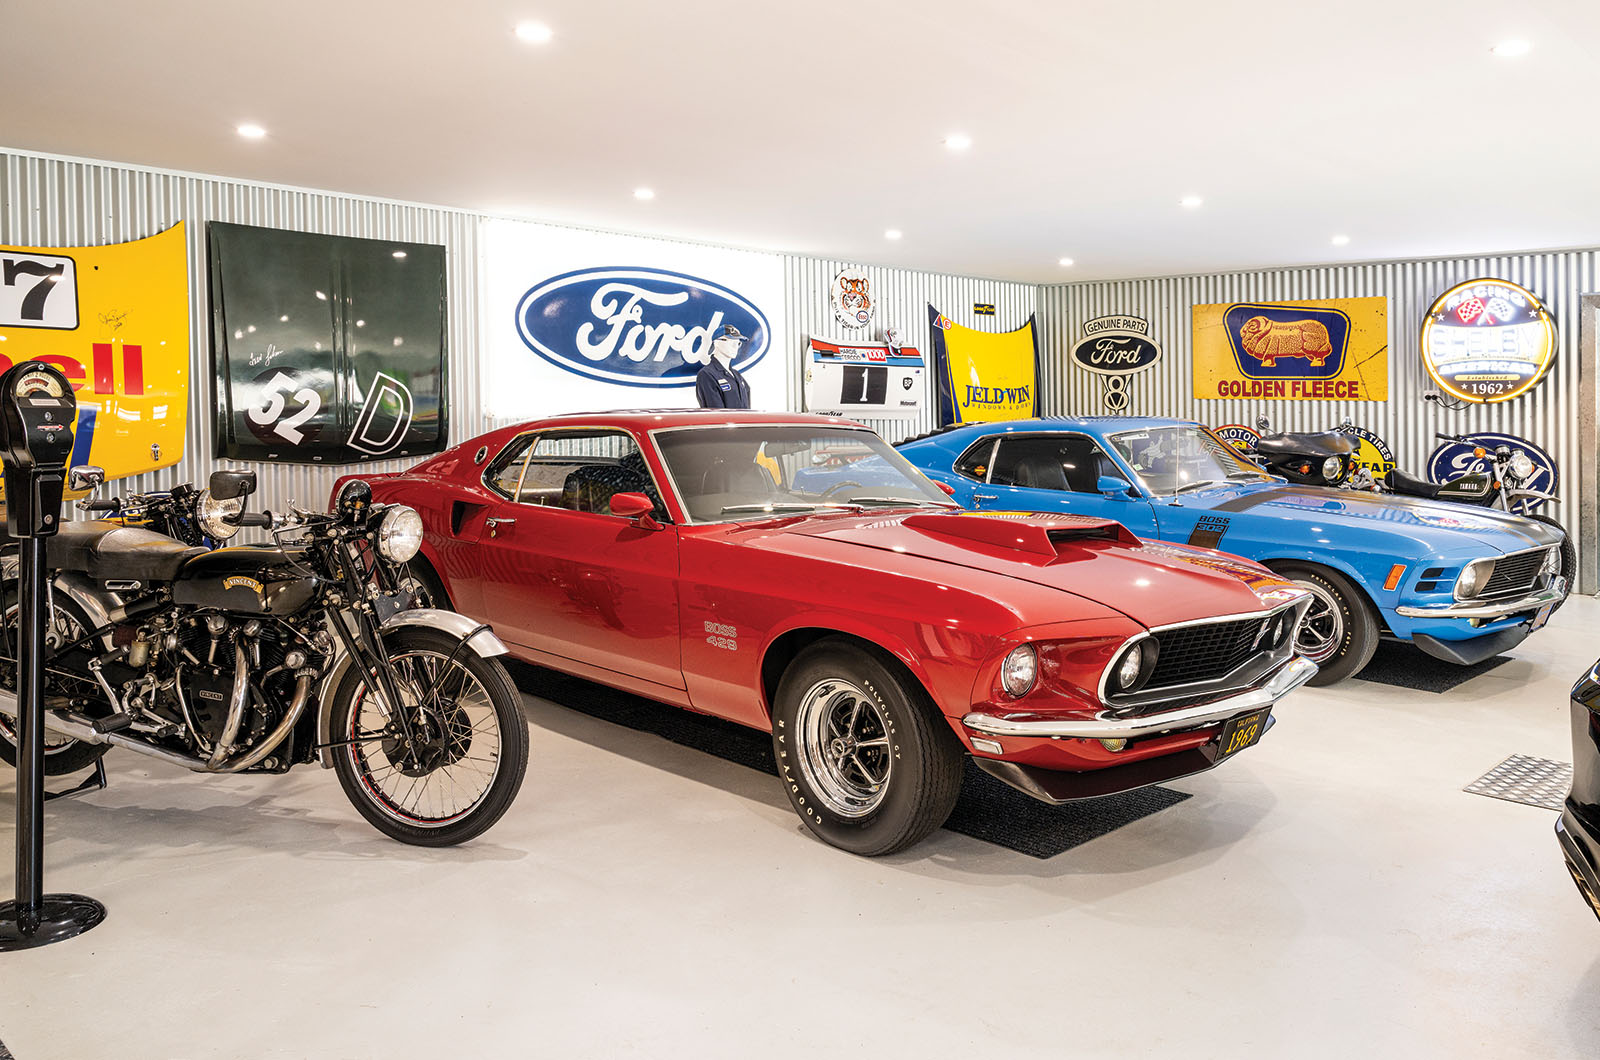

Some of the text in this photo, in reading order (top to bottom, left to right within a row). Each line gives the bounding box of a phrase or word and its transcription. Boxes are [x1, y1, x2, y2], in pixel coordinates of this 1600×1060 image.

[3, 259, 65, 321] 7
[576, 282, 725, 365] Ford
[1087, 319, 1146, 333] GENUINE PARTS
[1090, 338, 1142, 365] Ford
[860, 367, 869, 402] 1
[1217, 380, 1359, 398] GOLDEN FLEECE
[1472, 383, 1504, 395] 1962
[249, 371, 413, 455] 52 D
[1219, 428, 1258, 446] MOTOR
[1368, 433, 1391, 460] TIRES
[1196, 523, 1225, 532] 302
[1199, 515, 1231, 524] BOSS
[228, 578, 257, 588] VINCENT
[704, 620, 737, 638] BOSS
[706, 635, 738, 651] 429
[864, 680, 896, 734] POLYGLAS
[1225, 723, 1258, 753] 1969
[778, 719, 822, 825] GOODYEAR
